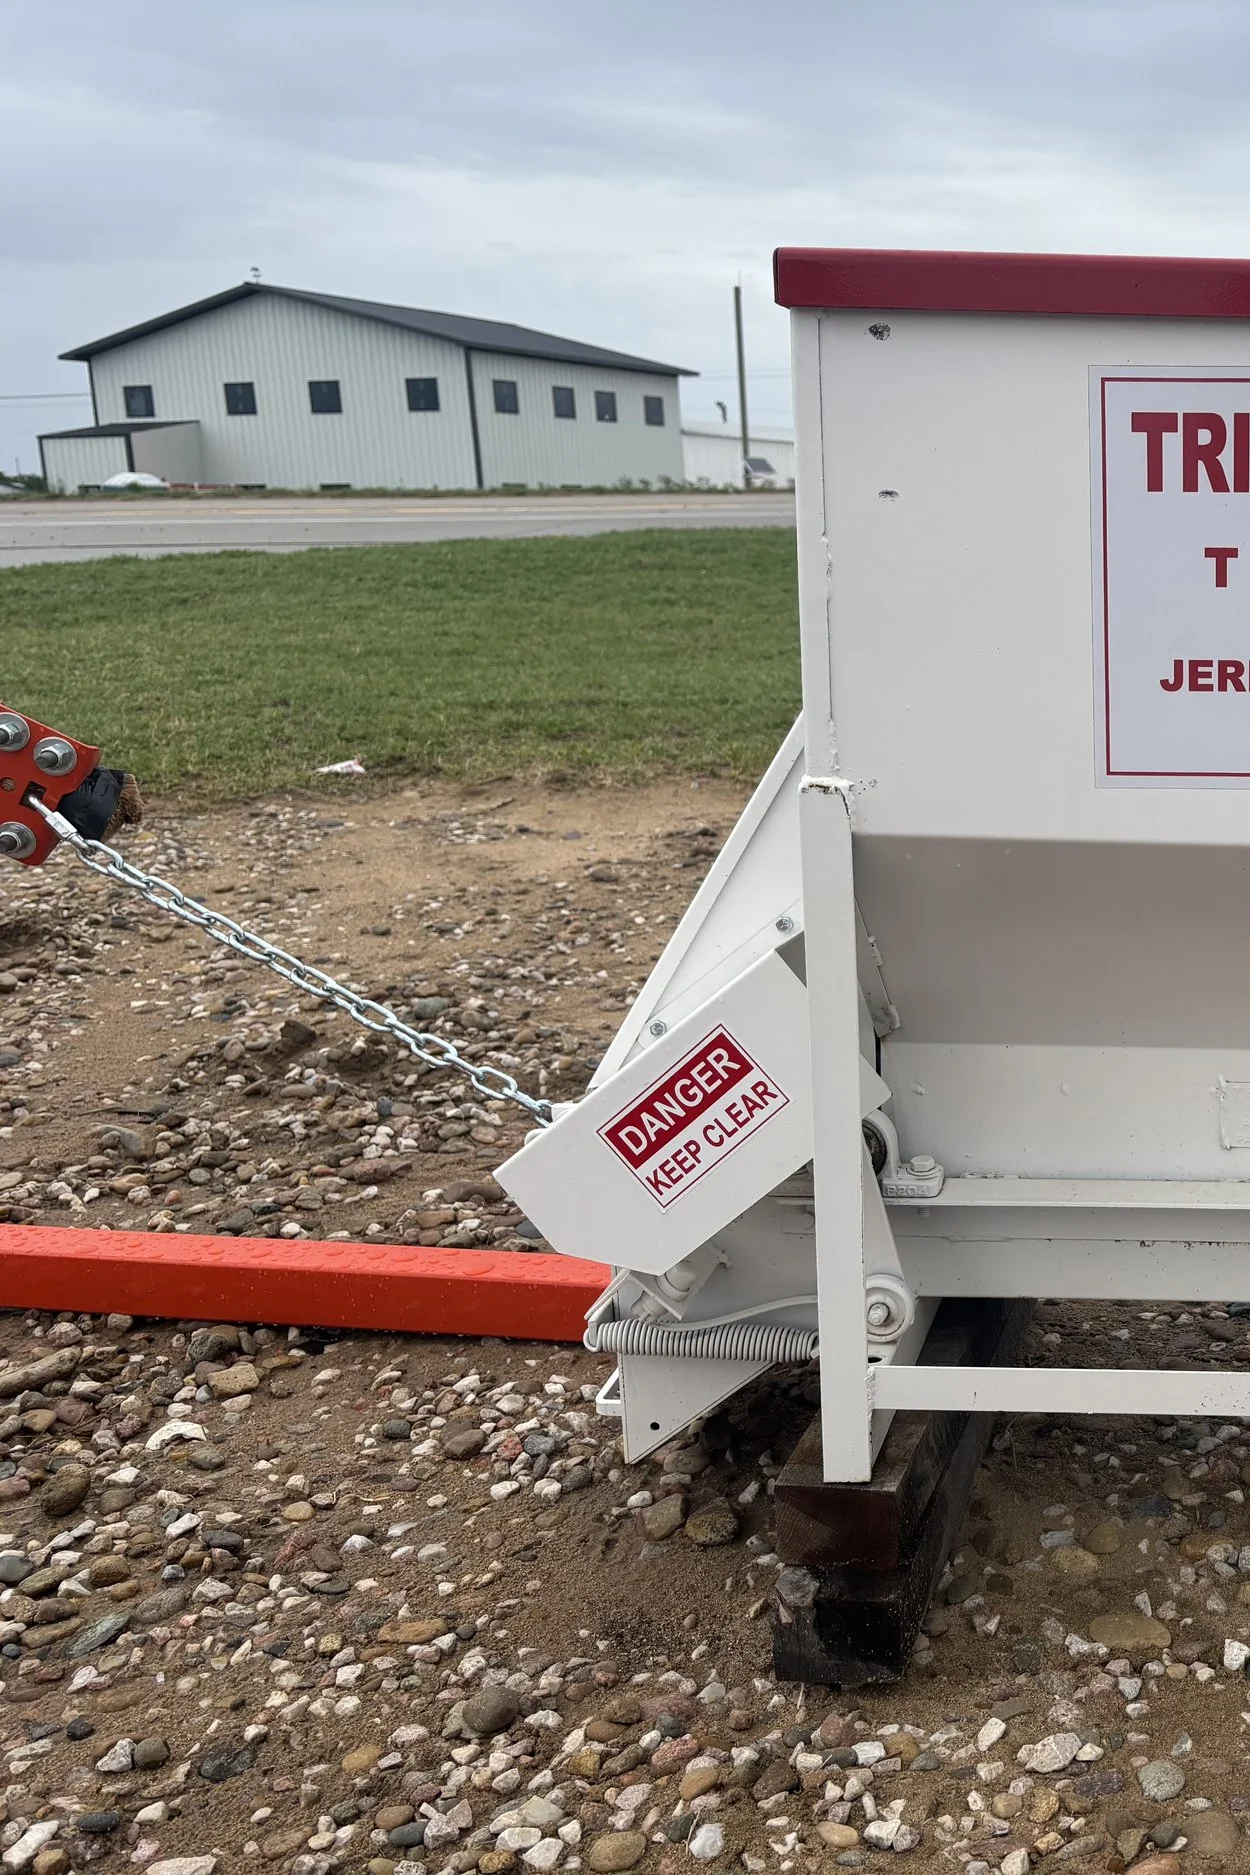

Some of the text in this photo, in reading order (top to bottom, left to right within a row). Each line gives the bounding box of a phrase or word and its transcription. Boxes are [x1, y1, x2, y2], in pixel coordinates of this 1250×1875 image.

[1204, 547, 1238, 588] T
[617, 1047, 742, 1156] DANGER
[645, 1080, 779, 1196] KEEP CLEAR
